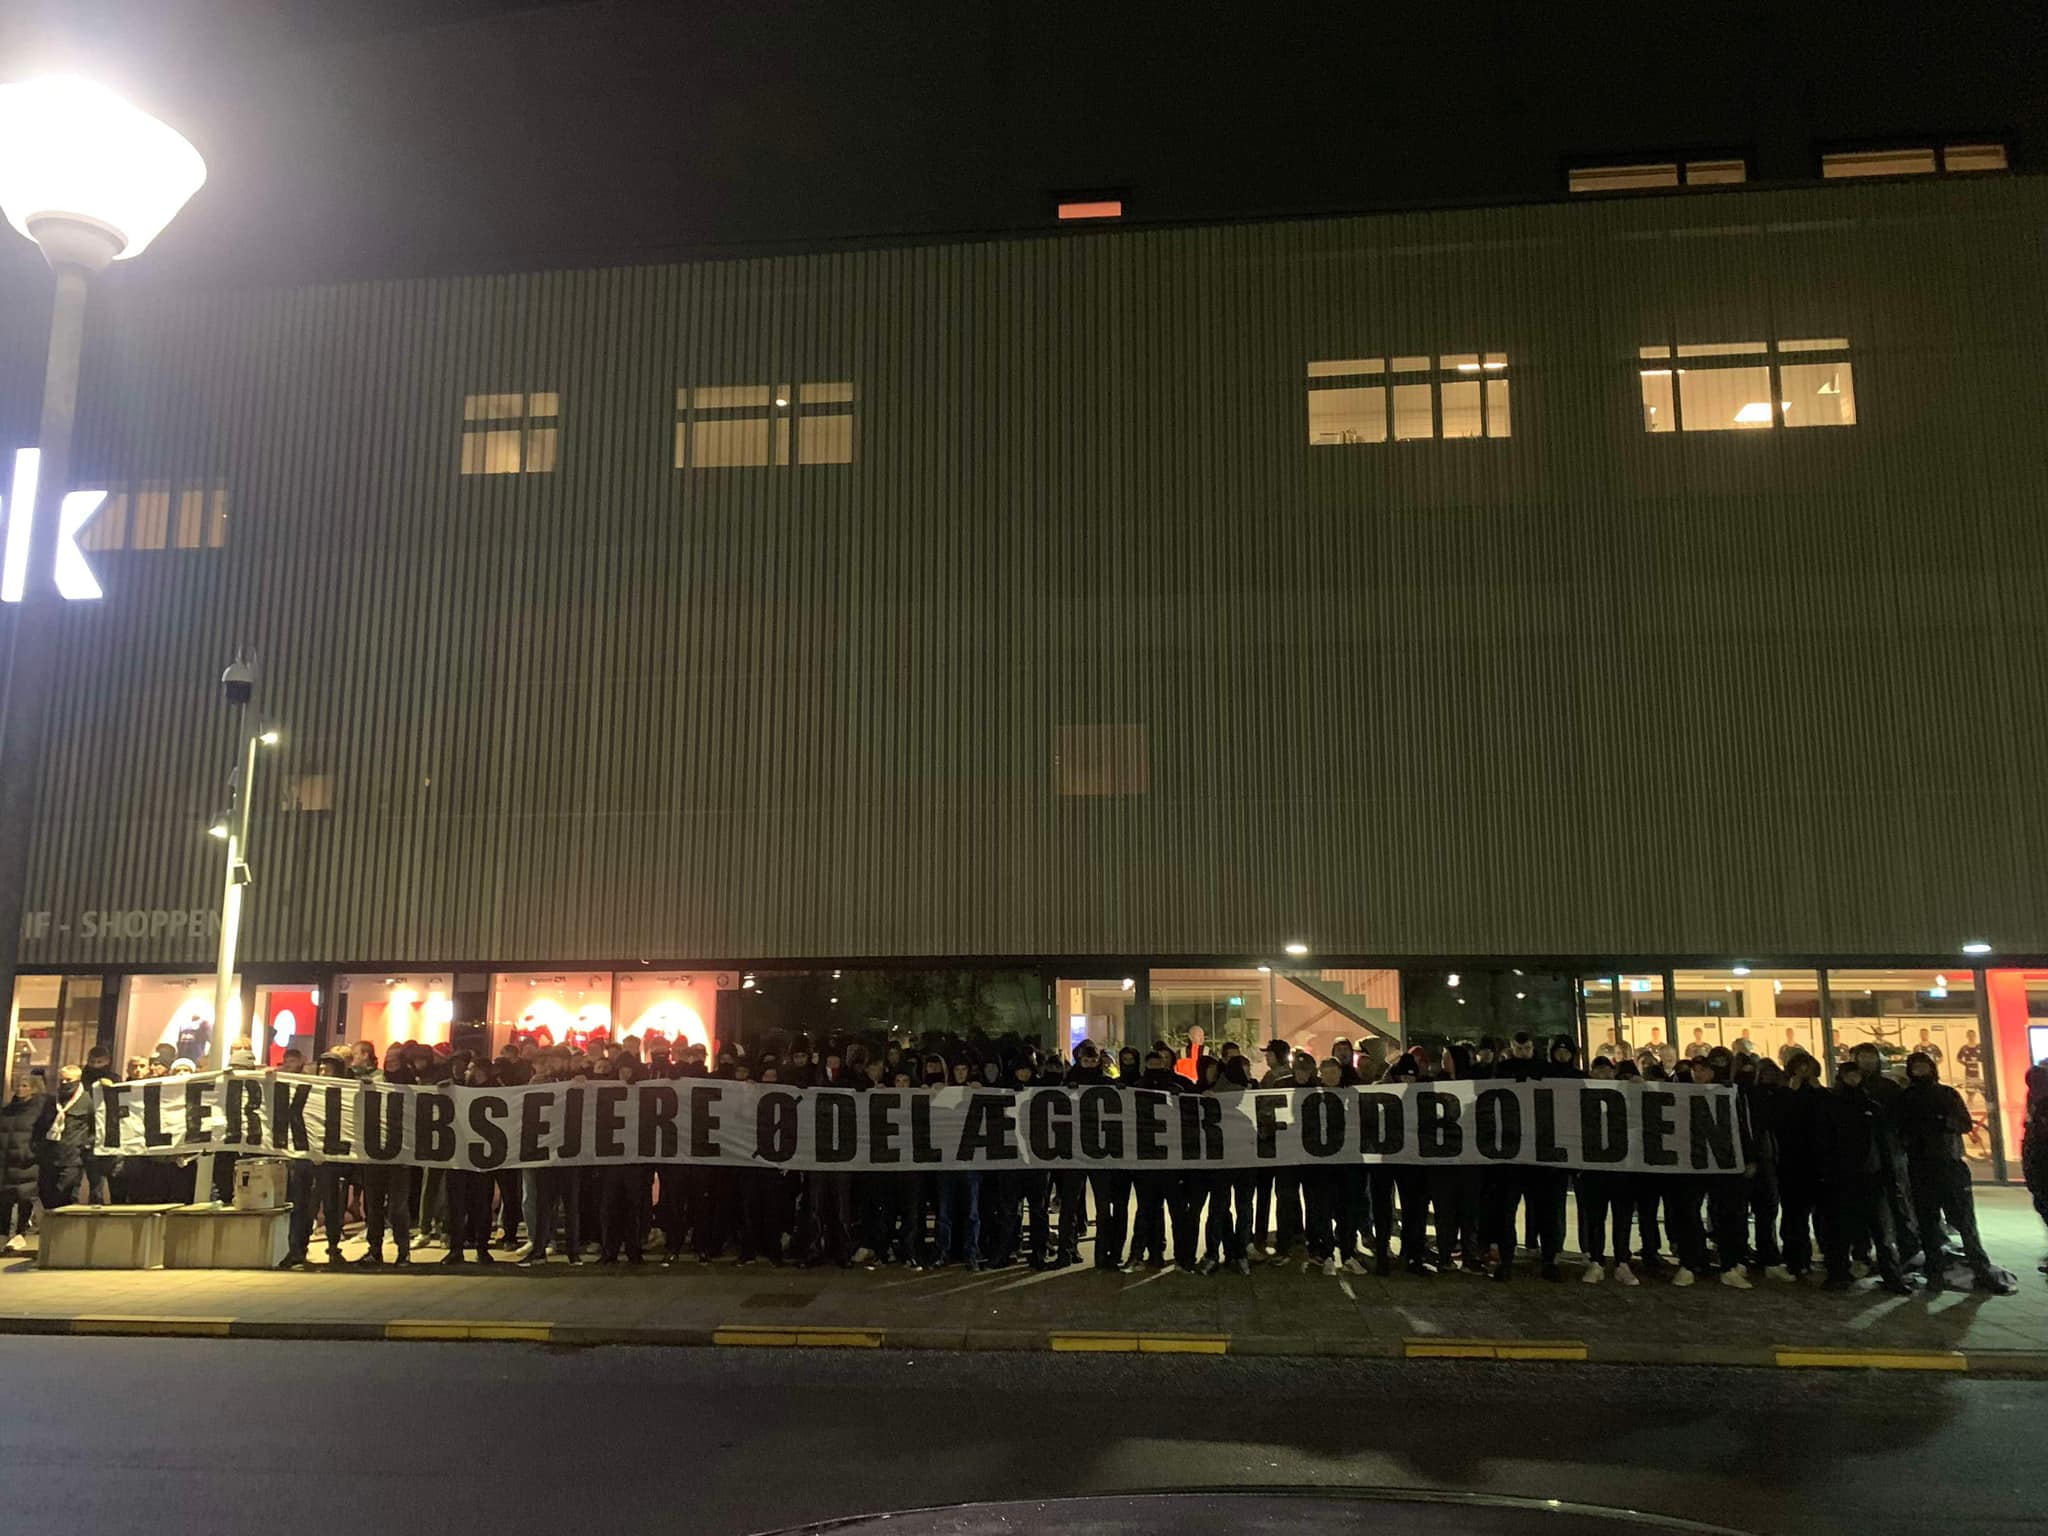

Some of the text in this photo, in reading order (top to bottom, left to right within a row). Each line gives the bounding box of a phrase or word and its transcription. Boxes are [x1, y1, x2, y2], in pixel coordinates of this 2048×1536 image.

[103, 1078, 1738, 1169] FLERKLUBSEJERE ØDELÆGGER FODBOLDEN
